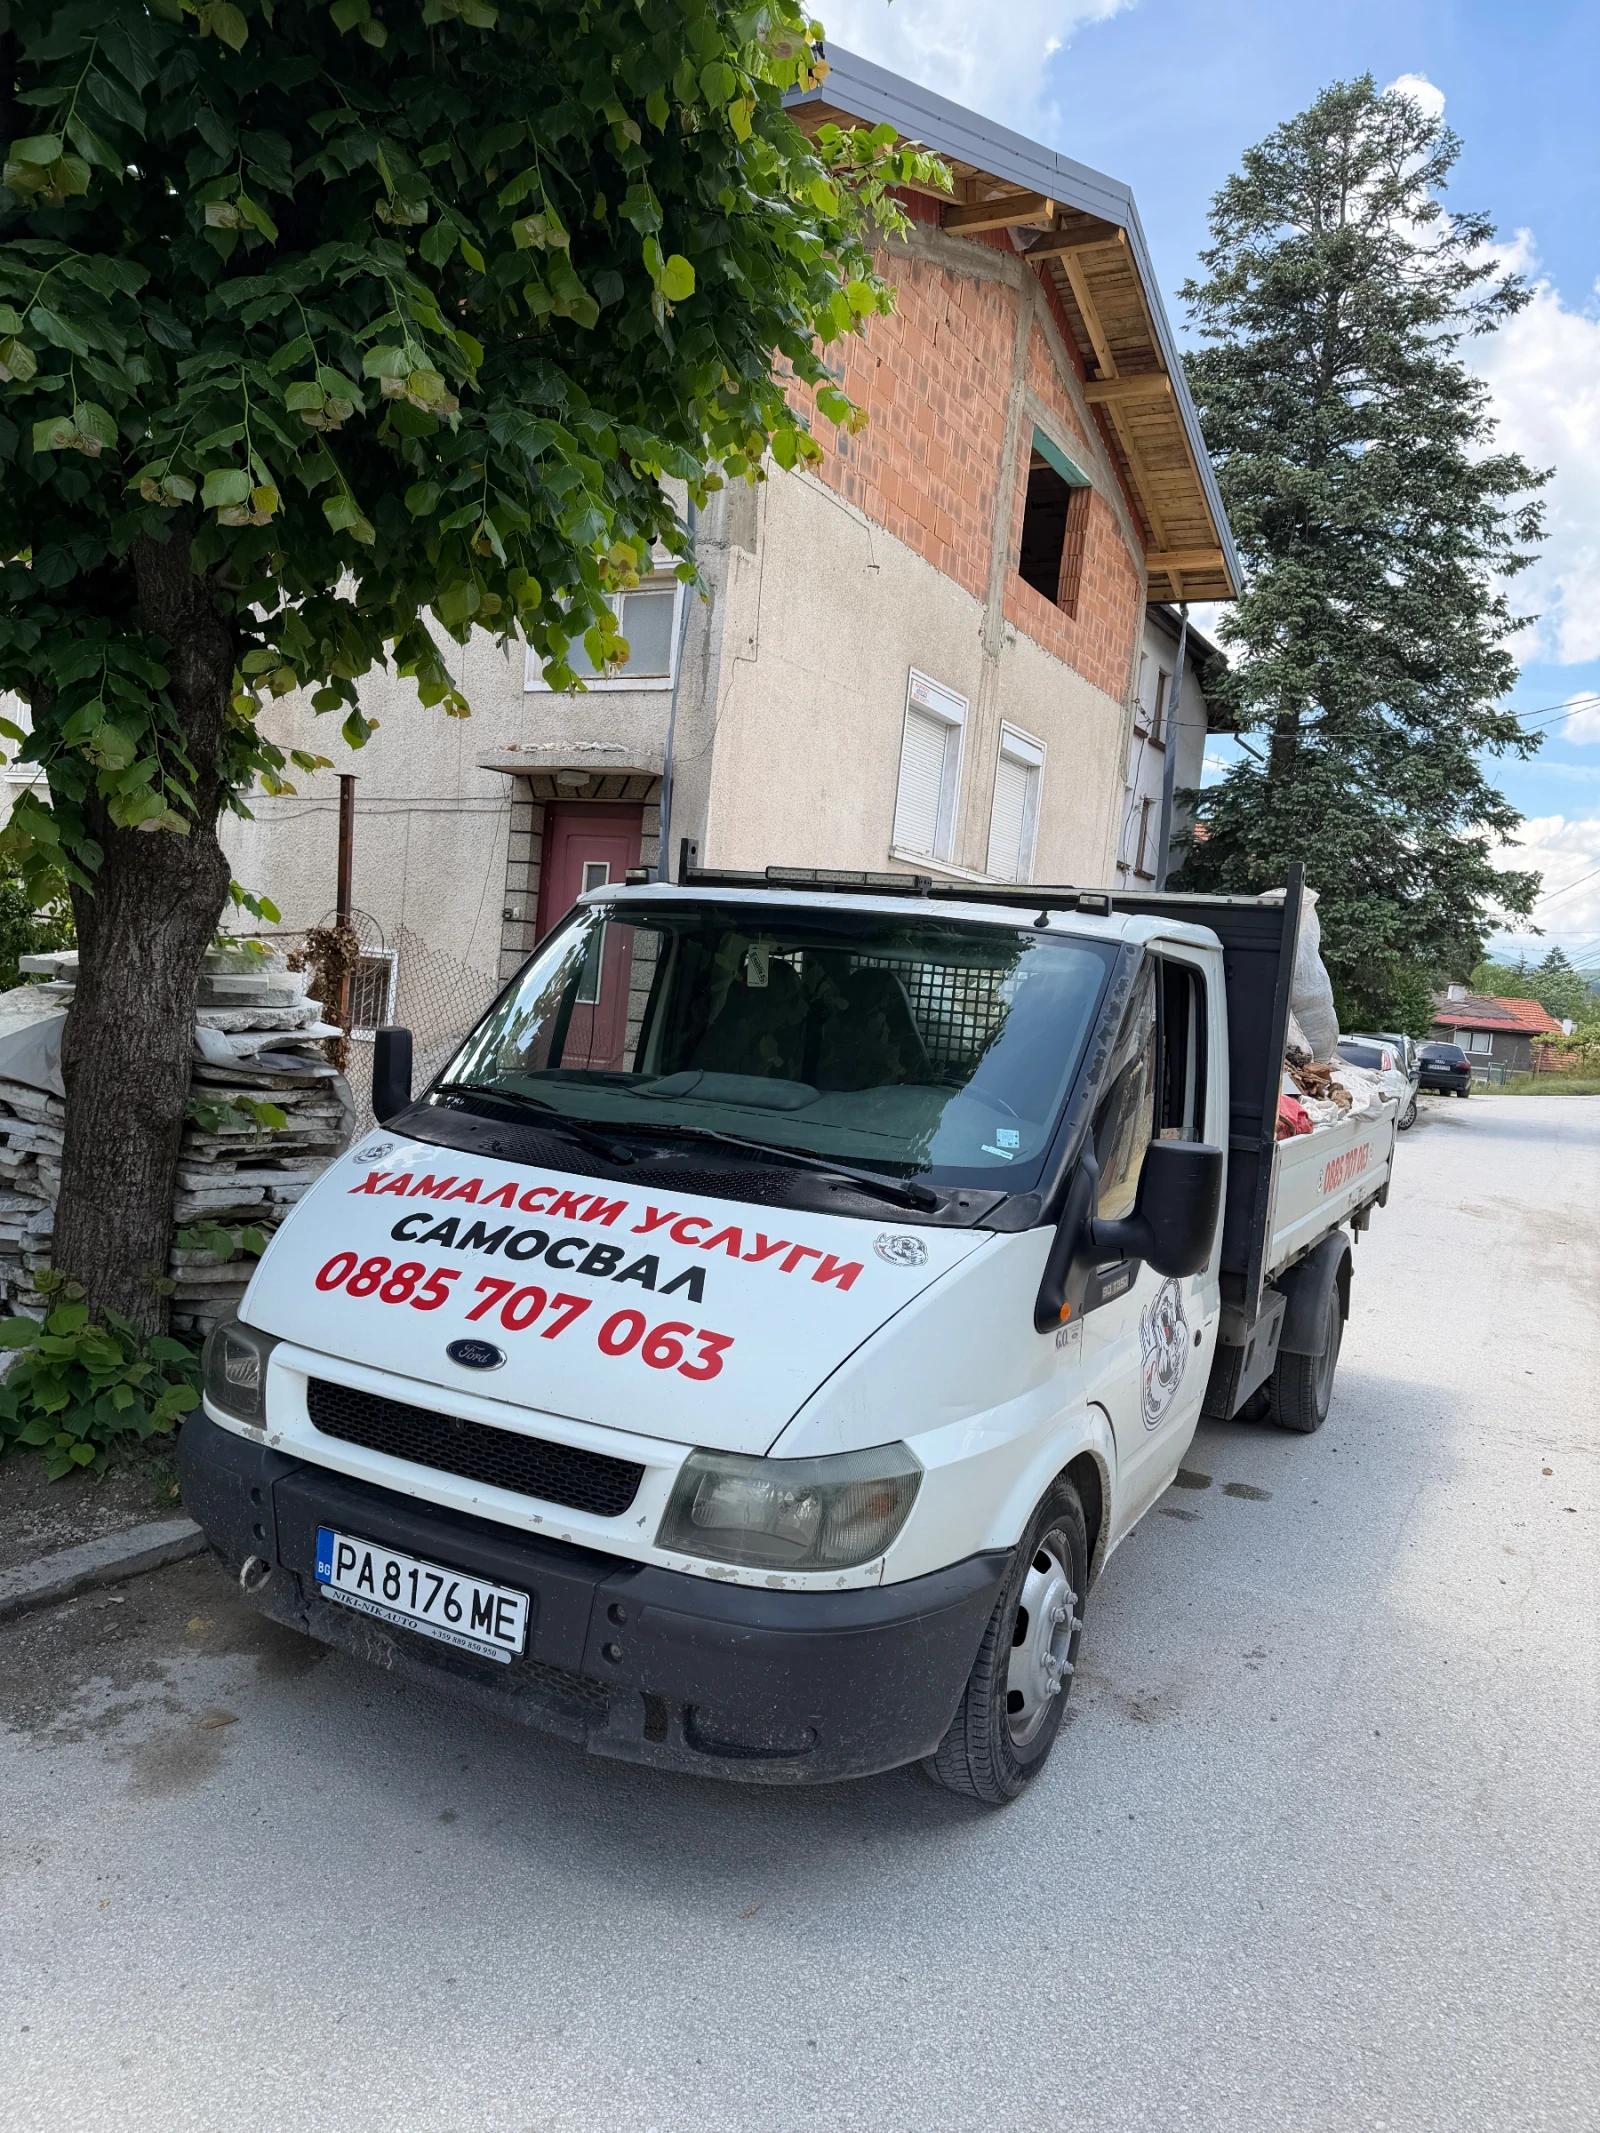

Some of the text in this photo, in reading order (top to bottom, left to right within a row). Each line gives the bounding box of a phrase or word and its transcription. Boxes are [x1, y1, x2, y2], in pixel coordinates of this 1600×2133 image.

[1323, 1155, 1344, 1195] 0885
[1343, 1148, 1357, 1183] 707
[347, 1172, 864, 1291] ХАМАЛСКИ УСЛУГИ
[390, 1212, 707, 1304] САМОСВАЛ
[315, 1251, 735, 1381] 0885 707 063
[458, 1343, 491, 1364] Ford
[318, 1561, 331, 1576] BG
[332, 1591, 418, 1629] NIKI-NIK AUTO
[431, 1629, 497, 1657] +359 889 850 950
